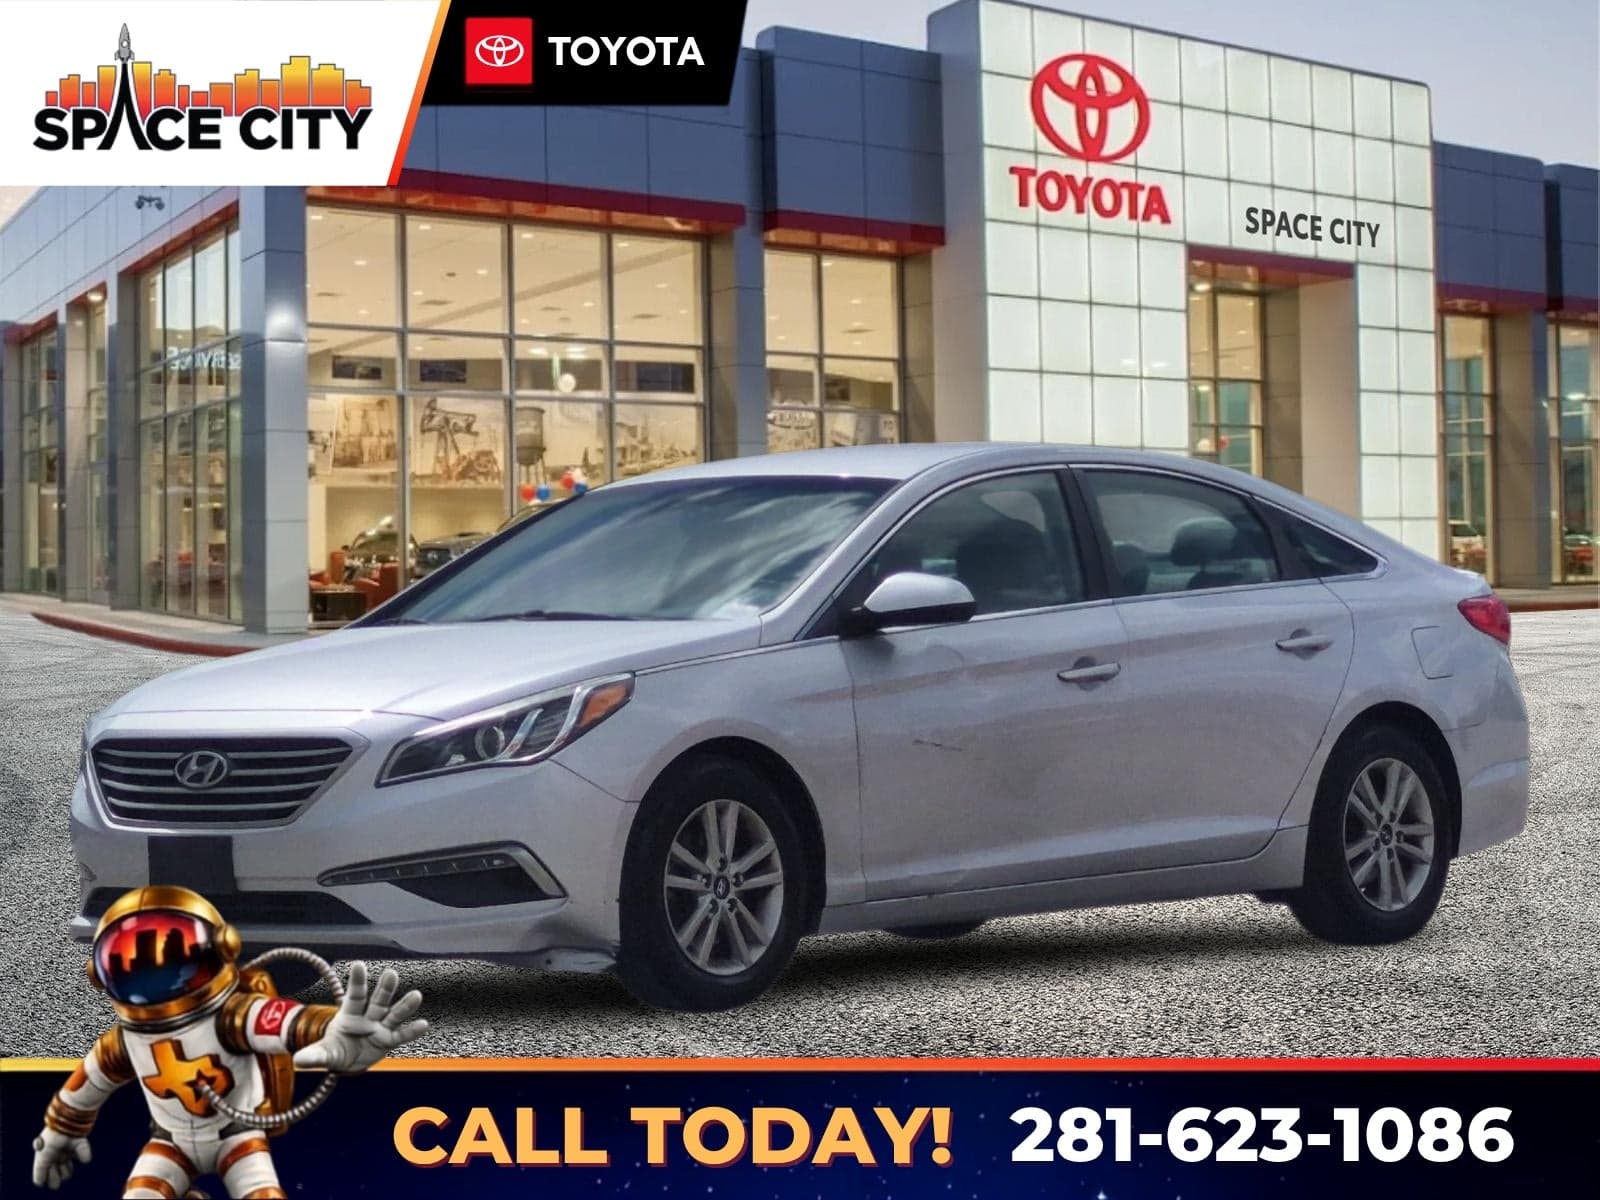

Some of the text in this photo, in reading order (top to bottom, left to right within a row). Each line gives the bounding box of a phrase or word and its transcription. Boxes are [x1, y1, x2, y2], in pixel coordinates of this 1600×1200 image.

[1009, 166, 1172, 225] TOYOTA
[1244, 206, 1381, 248] SPACE CITY
